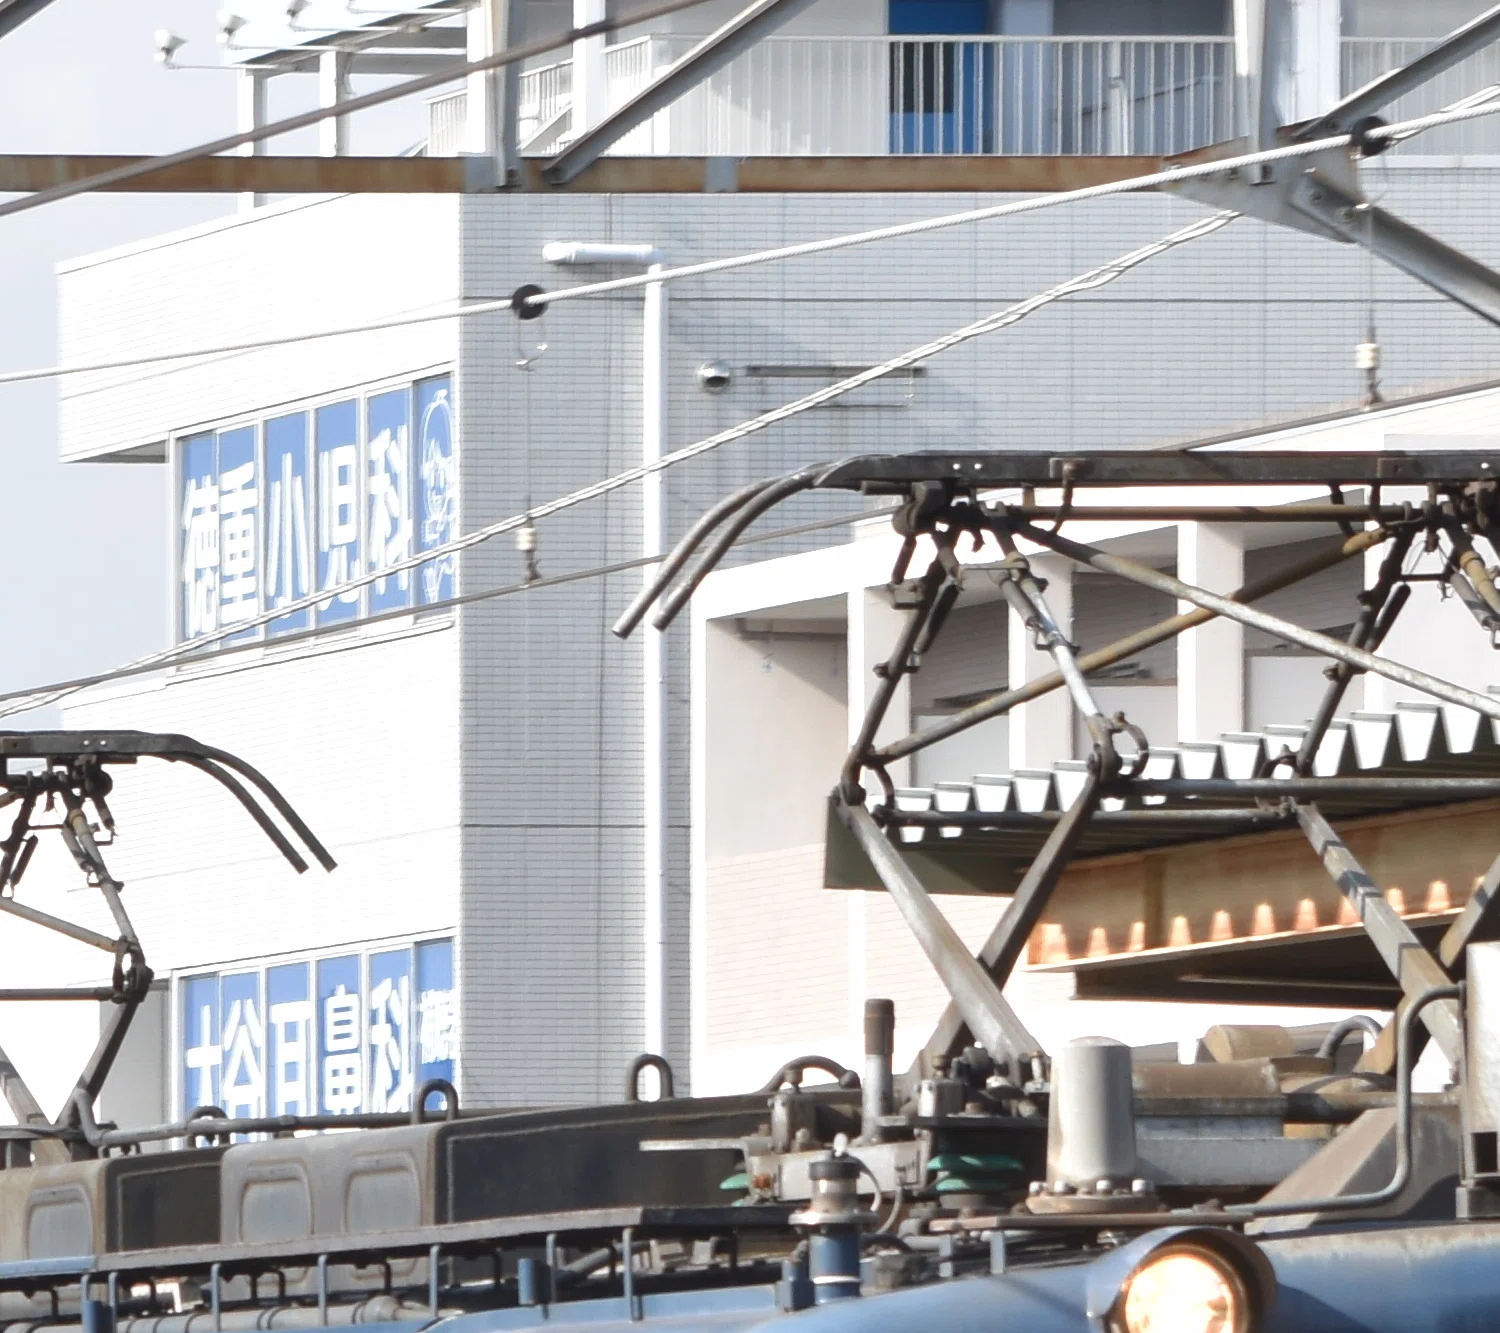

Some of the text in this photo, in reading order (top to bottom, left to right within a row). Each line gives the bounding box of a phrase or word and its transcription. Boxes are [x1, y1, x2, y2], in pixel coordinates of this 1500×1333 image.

[183, 425, 413, 638] 徳重小児科
